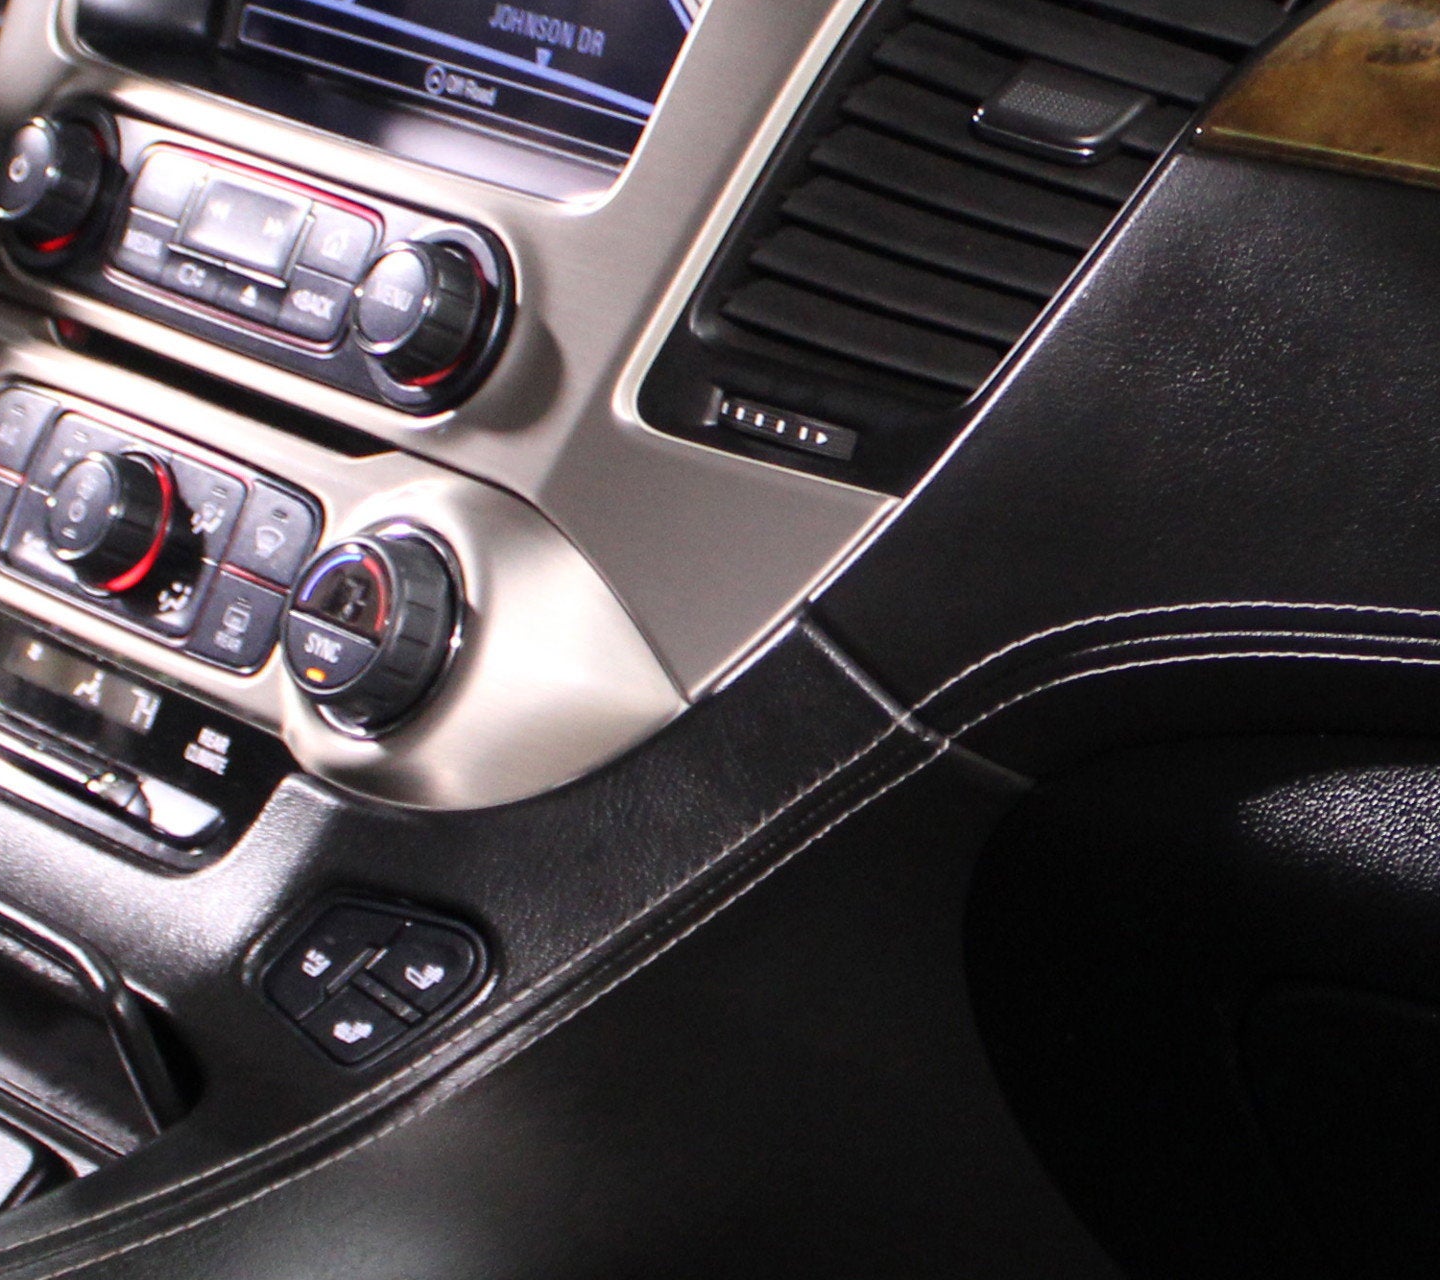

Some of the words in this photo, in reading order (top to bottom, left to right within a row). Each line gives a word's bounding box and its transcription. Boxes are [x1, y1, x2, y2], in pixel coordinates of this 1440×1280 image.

[489, 3, 577, 49] JOHNSON
[576, 25, 606, 57] DR
[304, 632, 343, 664] SYNC
